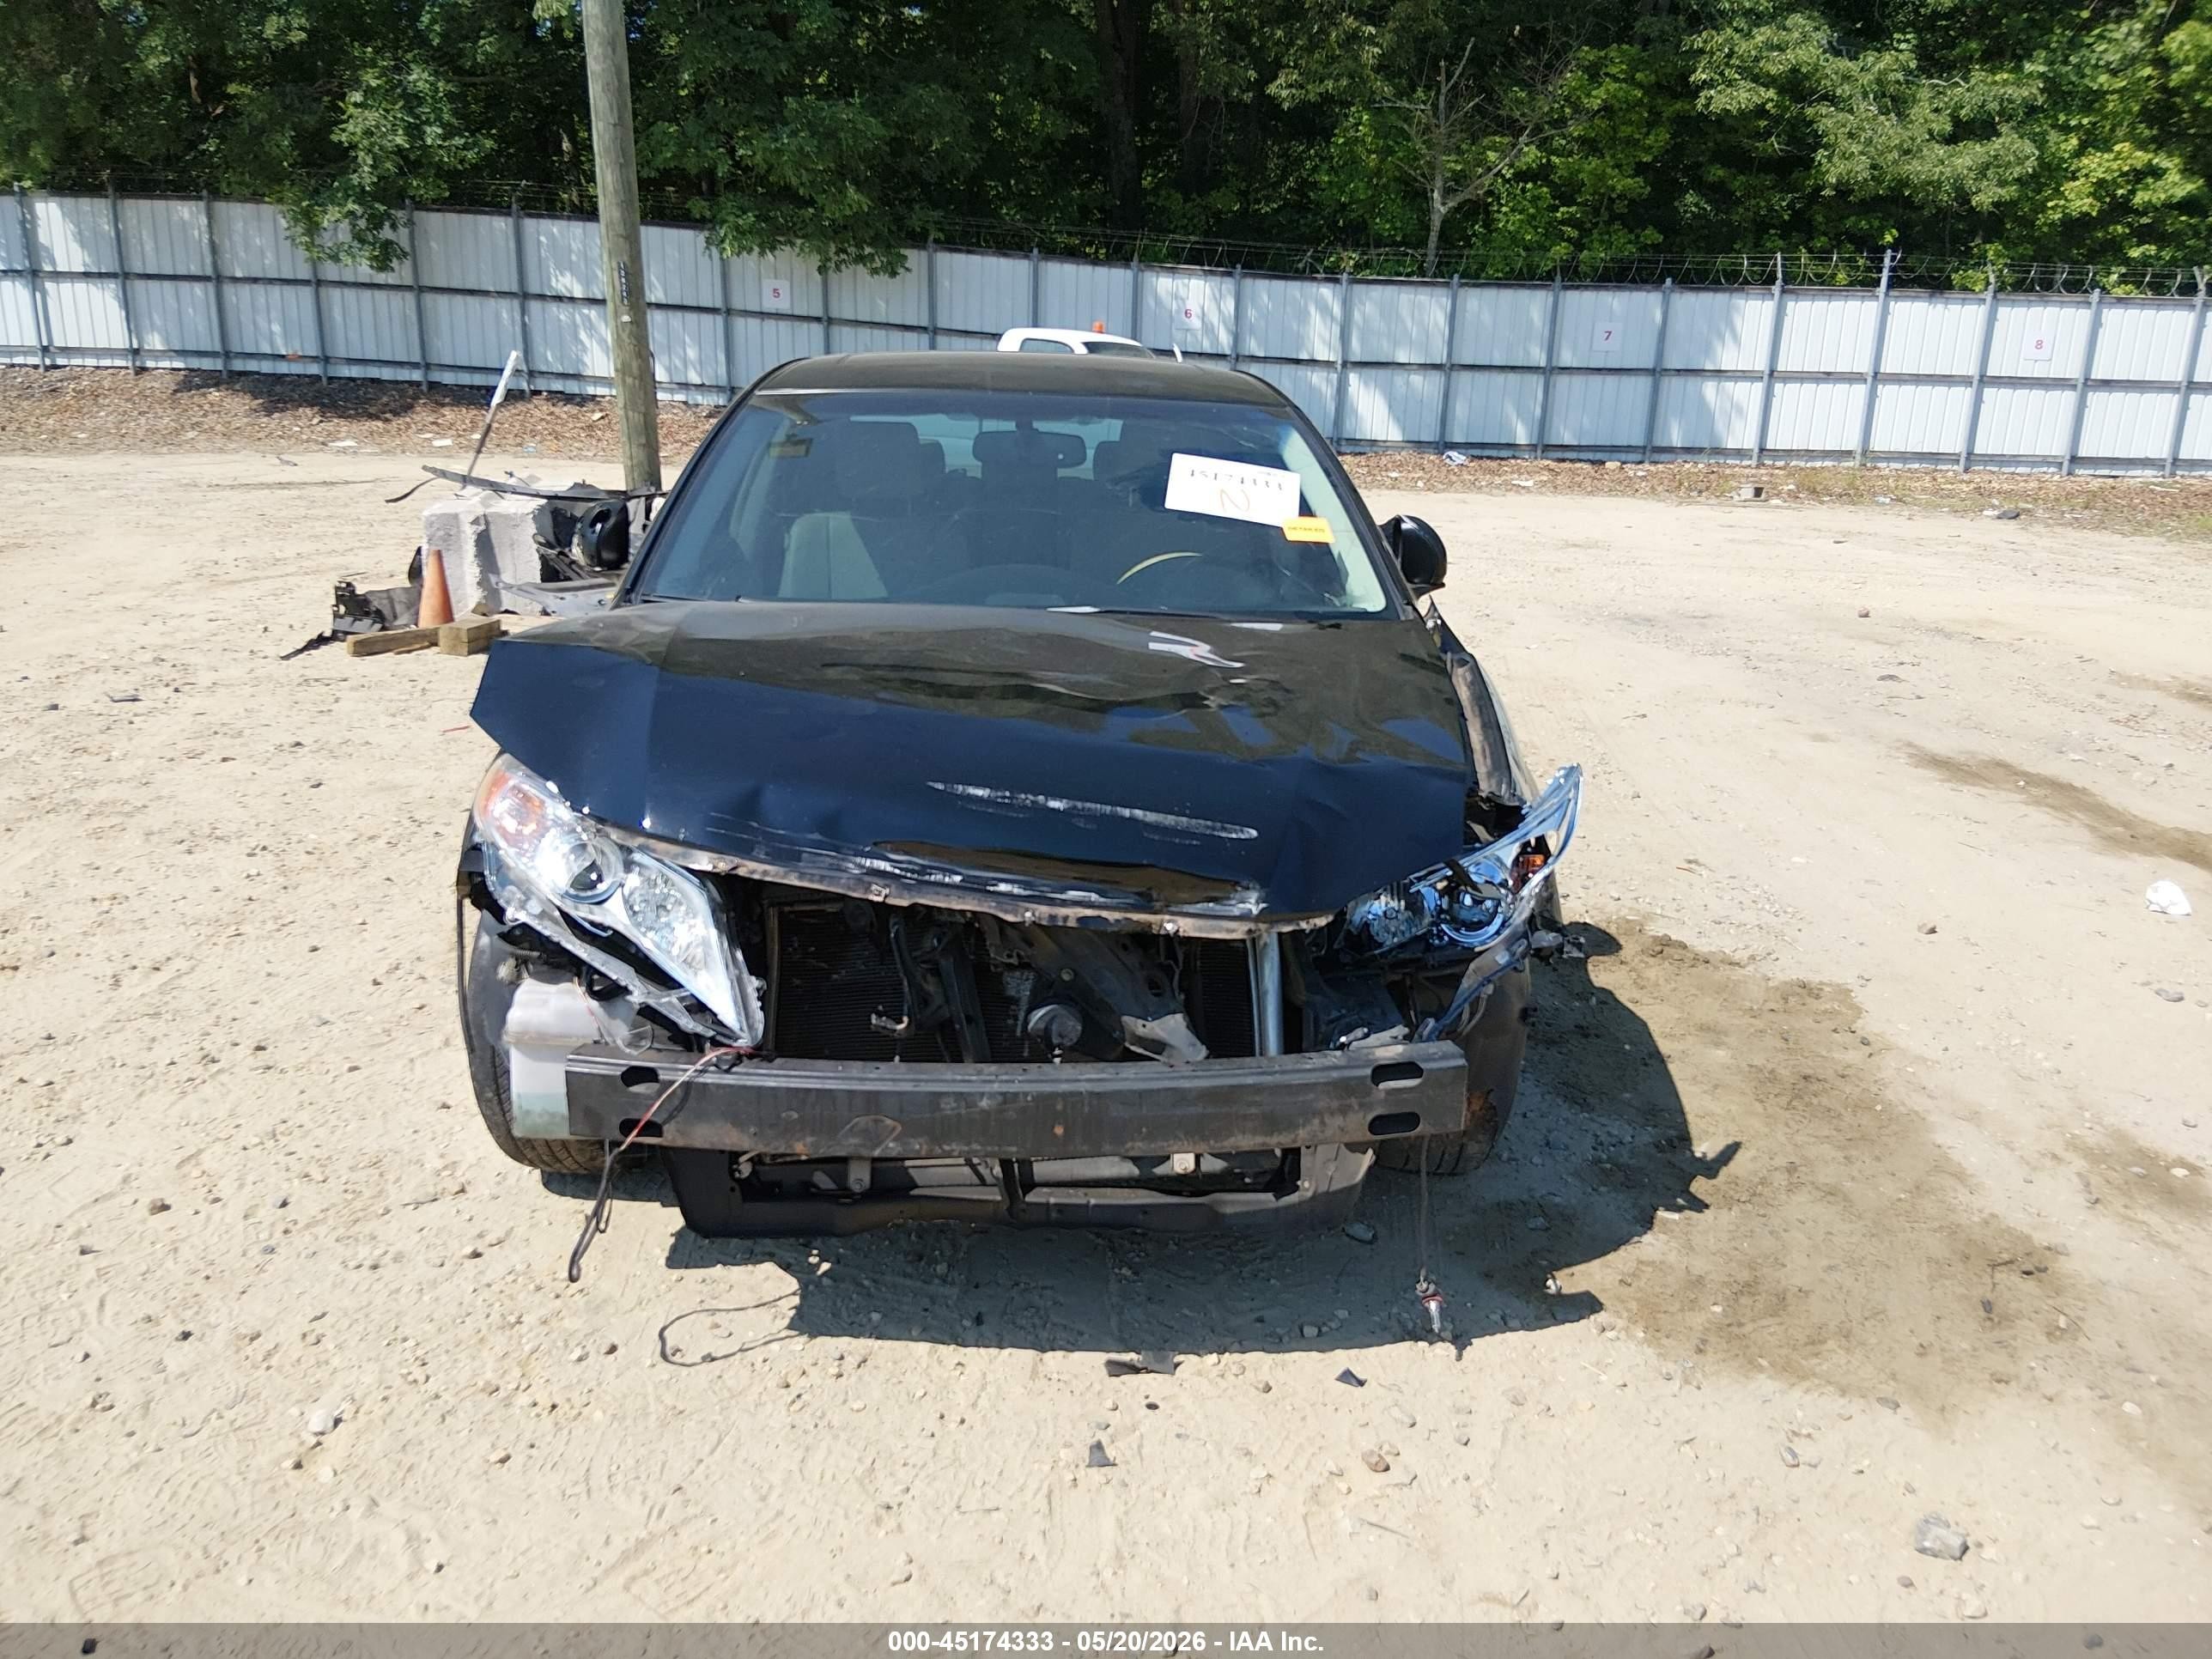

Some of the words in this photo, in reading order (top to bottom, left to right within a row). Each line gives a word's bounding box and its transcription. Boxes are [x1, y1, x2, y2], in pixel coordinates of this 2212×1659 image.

[773, 288, 781, 299] 5
[1184, 308, 1193, 319] 6
[1604, 331, 1613, 341] 7
[2035, 339, 2044, 349] 8
